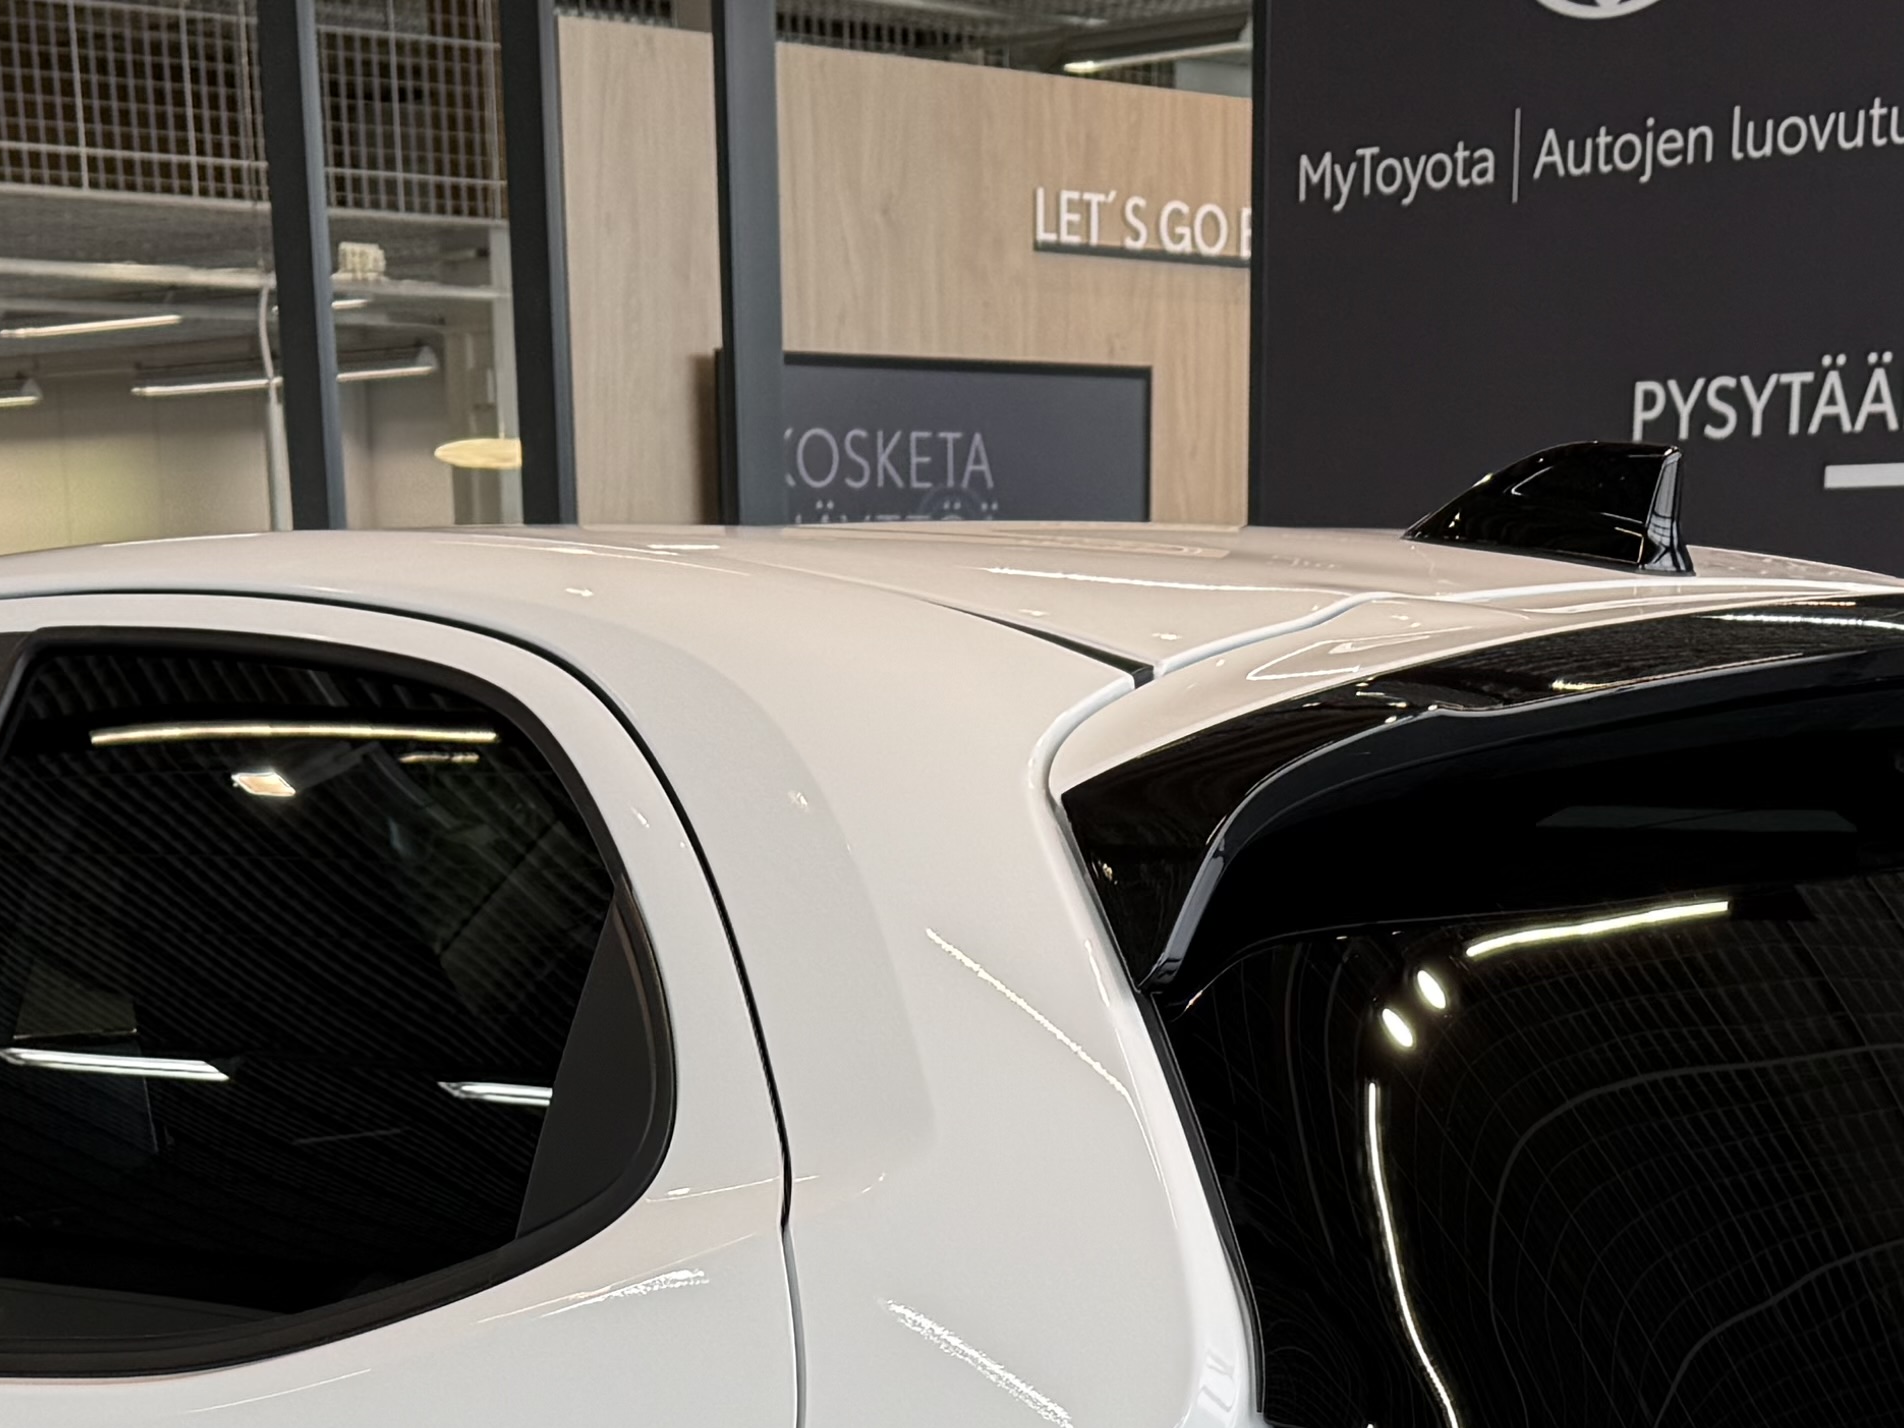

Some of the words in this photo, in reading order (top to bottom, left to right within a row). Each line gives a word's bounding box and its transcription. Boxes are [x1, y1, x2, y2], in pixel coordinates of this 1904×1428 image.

[1297, 147, 1496, 213] MyToyota
[1533, 120, 1714, 184] Autojen
[1159, 200, 1228, 257] GO
[783, 426, 995, 489] OSKETA
